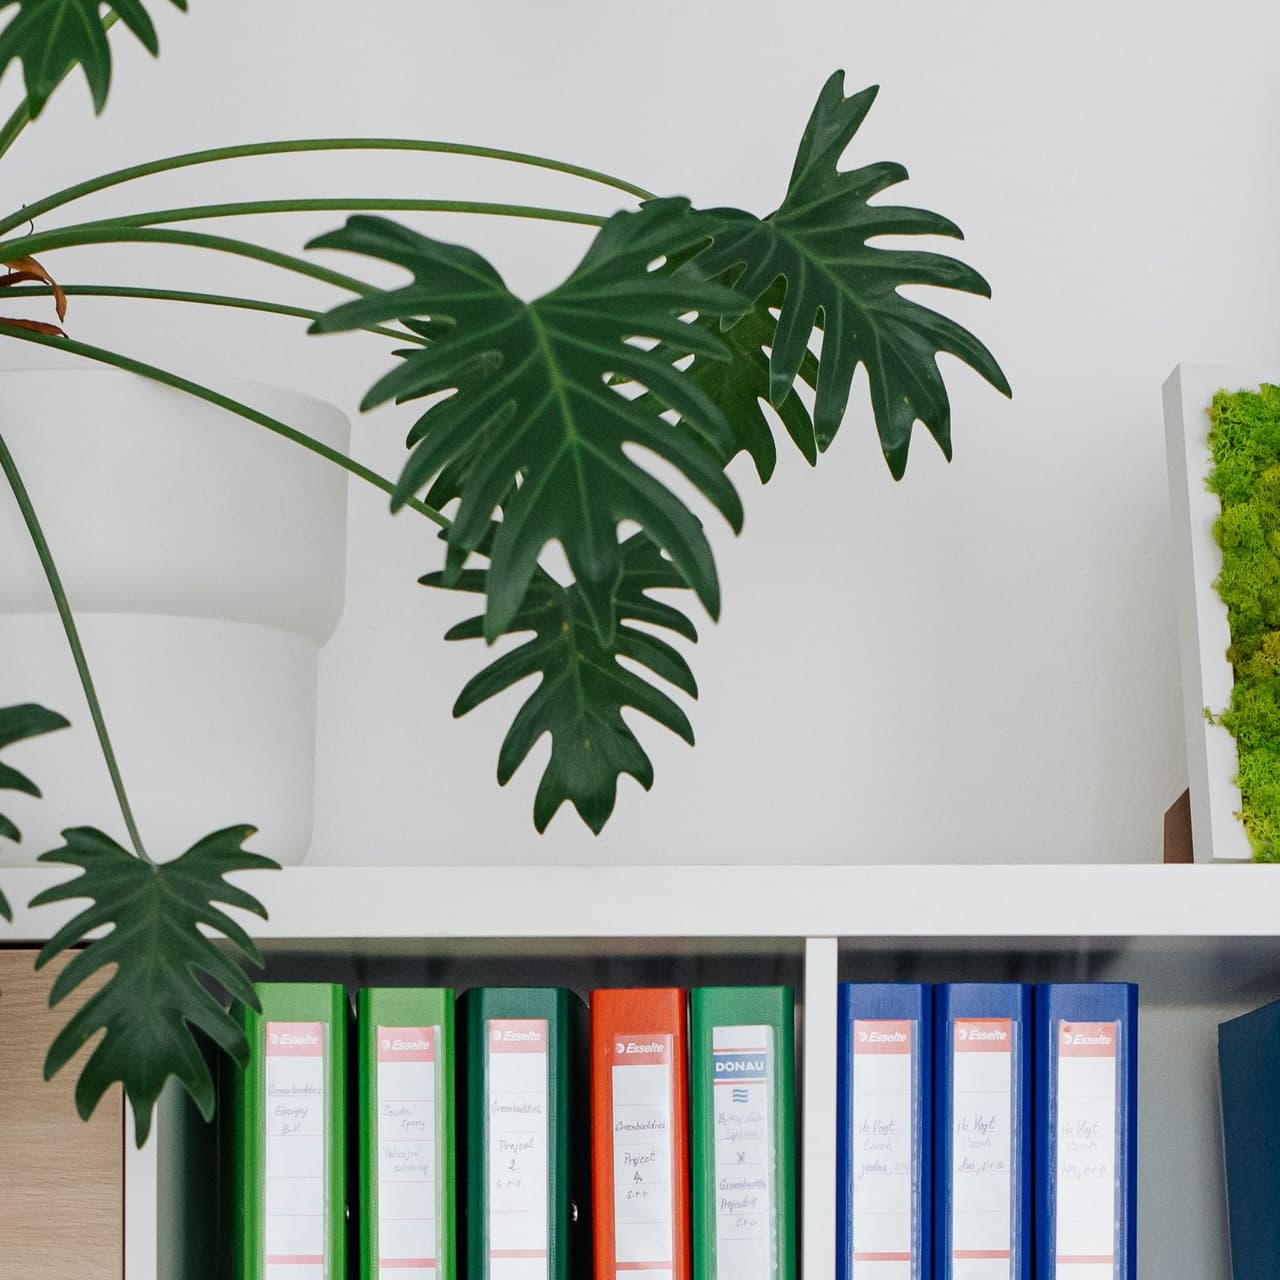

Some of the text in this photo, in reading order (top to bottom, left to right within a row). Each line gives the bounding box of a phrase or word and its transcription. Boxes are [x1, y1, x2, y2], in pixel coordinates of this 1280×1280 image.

[280, 1033, 319, 1045] Esselte
[503, 1031, 541, 1042] Esselte
[868, 1031, 908, 1043] Esselte
[969, 1029, 1007, 1041] Esselte
[1073, 1034, 1111, 1046] Esselte
[392, 1040, 430, 1051] Esselte
[626, 1042, 665, 1054] Esselte
[715, 1061, 765, 1073] DONAU
[974, 1114, 996, 1135] Vogt
[507, 1158, 517, 1171] 2
[624, 1150, 656, 1167] Project
